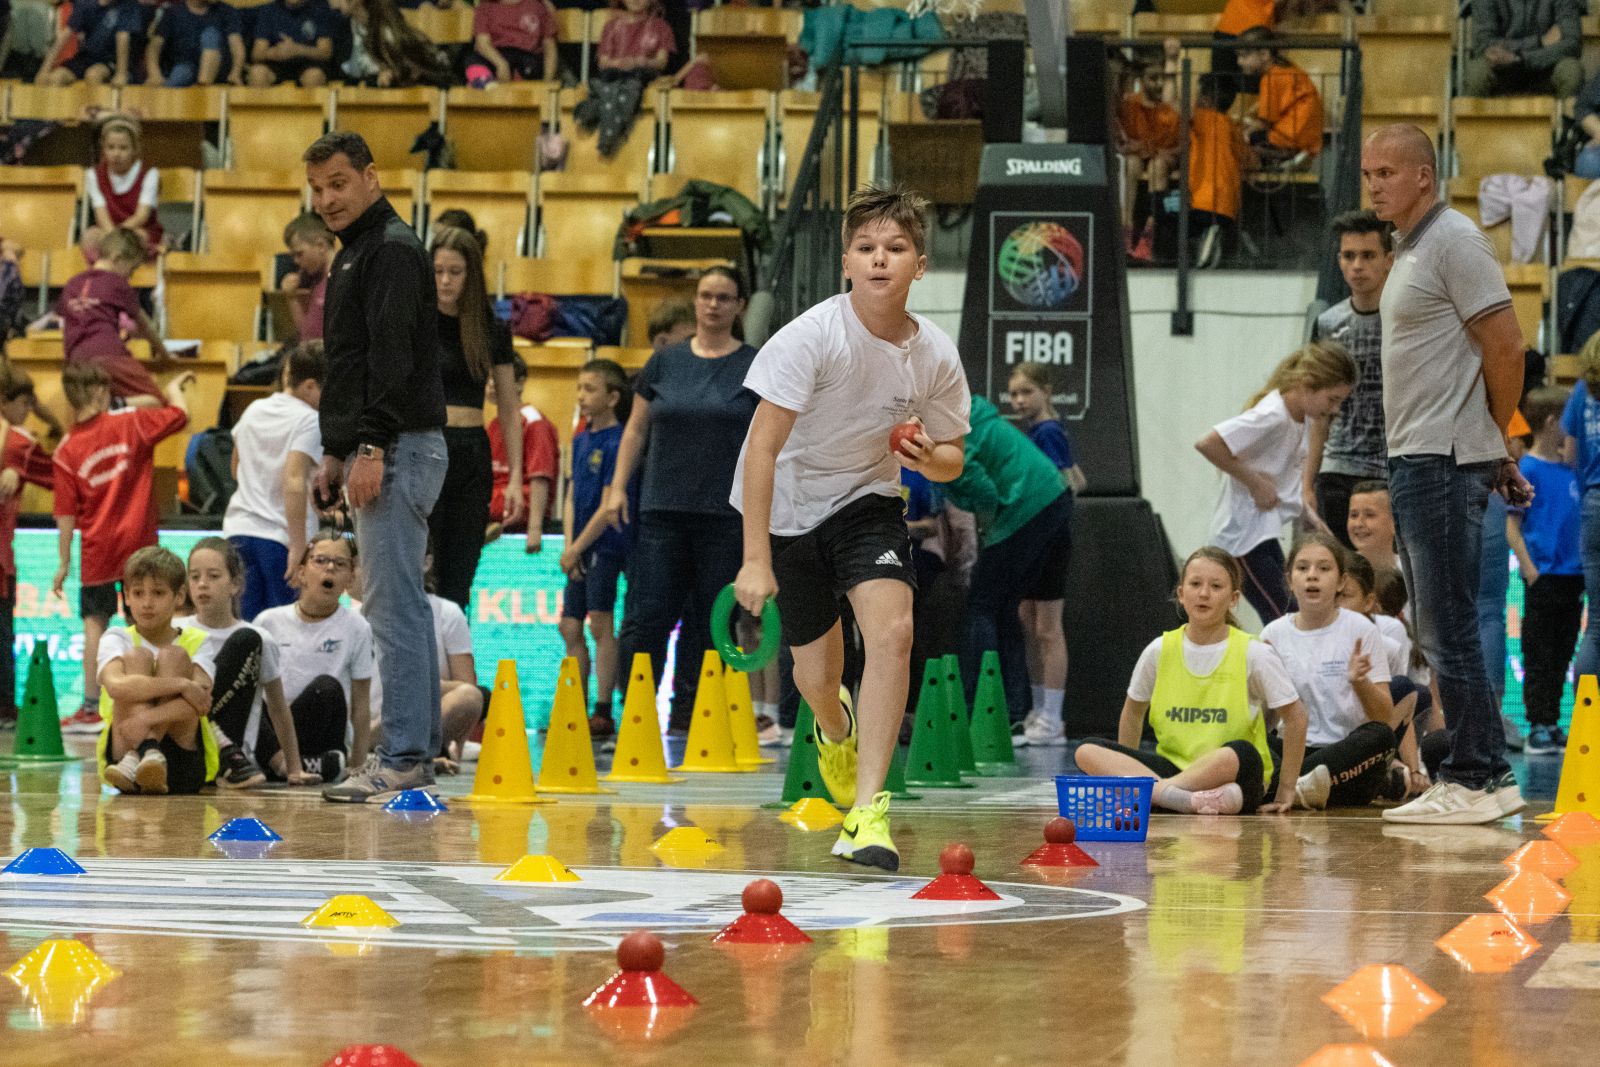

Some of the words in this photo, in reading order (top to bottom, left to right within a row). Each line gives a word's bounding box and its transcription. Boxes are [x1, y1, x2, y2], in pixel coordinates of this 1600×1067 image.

[1006, 158, 1081, 176] SPALDING
[1005, 331, 1073, 365] FIBA
[478, 589, 564, 623] KLU
